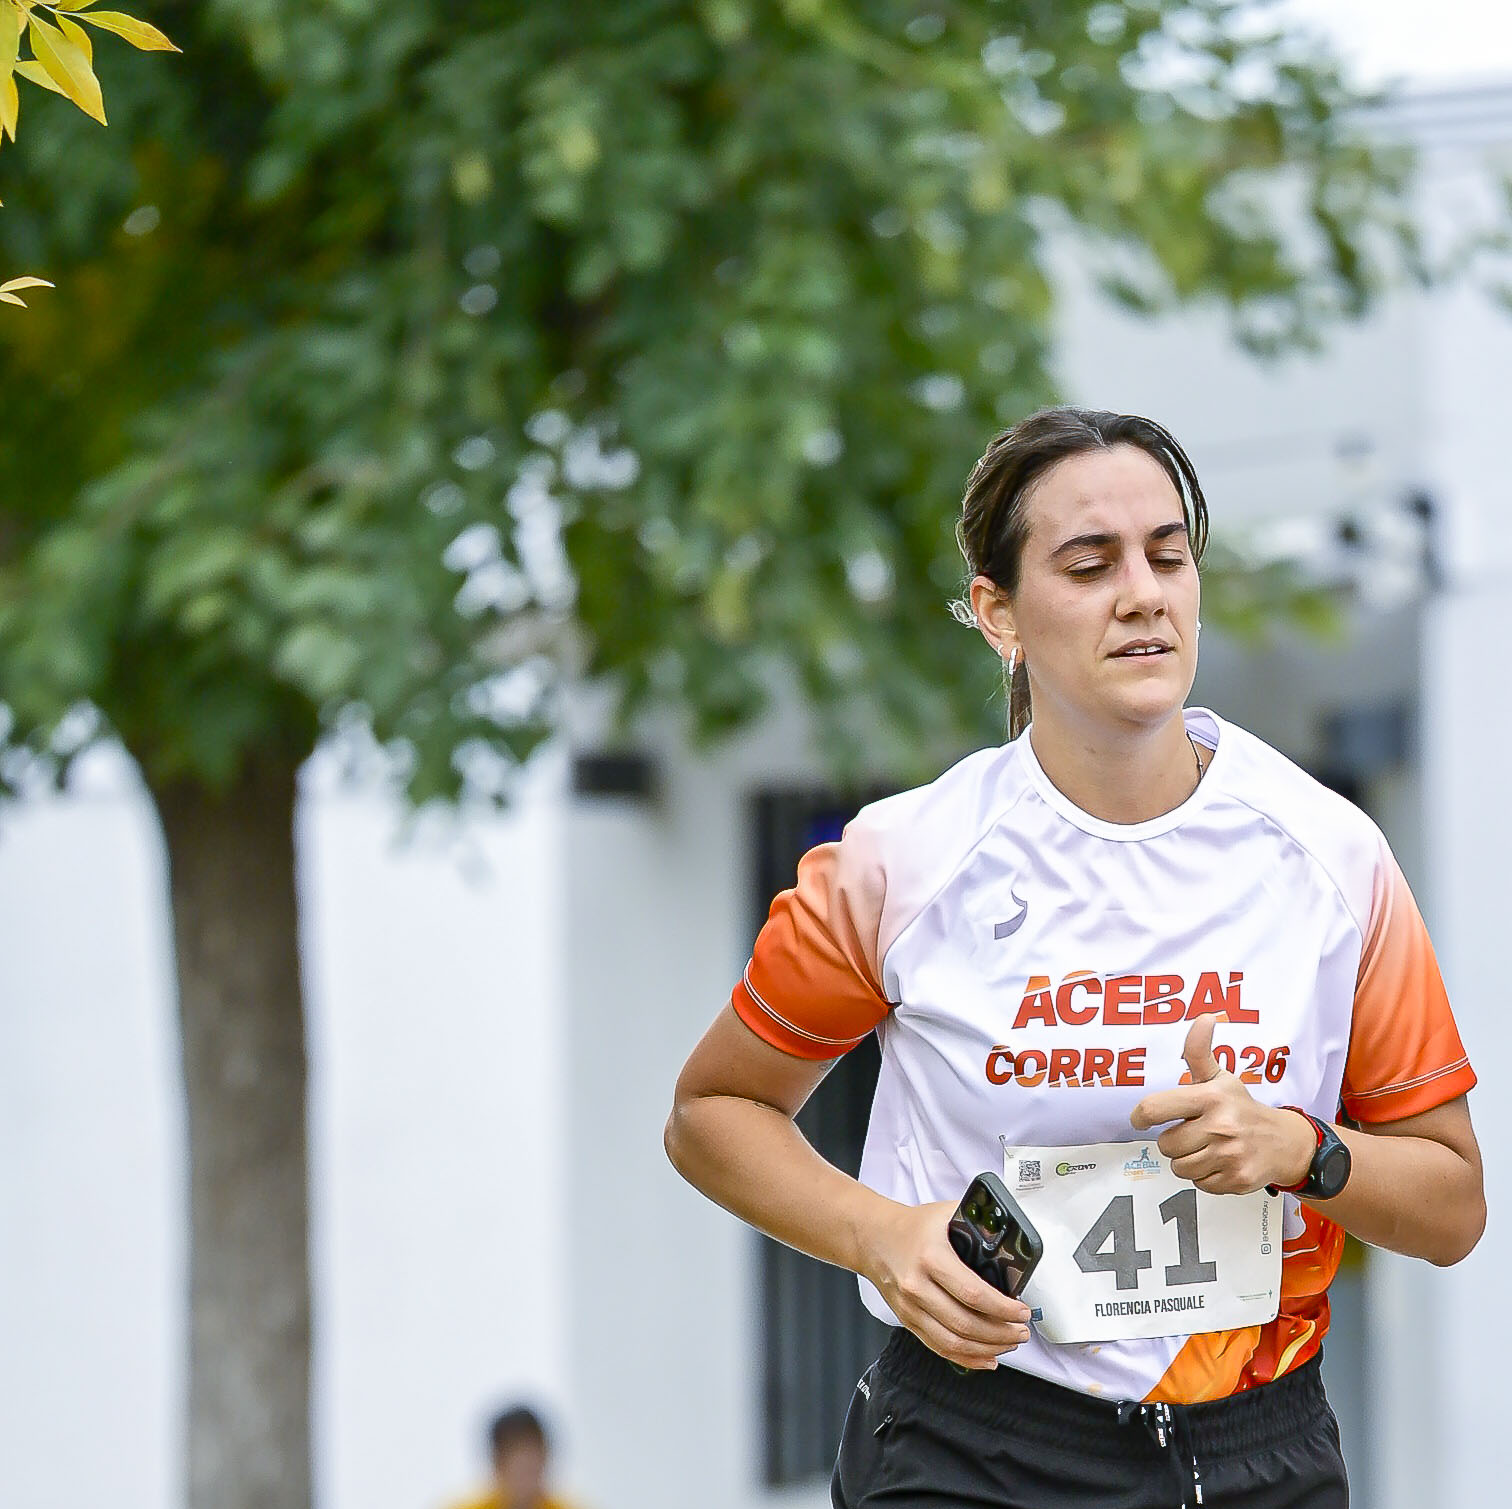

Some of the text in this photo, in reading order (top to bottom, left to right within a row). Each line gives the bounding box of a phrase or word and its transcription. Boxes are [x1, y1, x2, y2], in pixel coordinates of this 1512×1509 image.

[1011, 969, 1260, 1030] ACEBAL
[985, 1044, 1291, 1088] CORRE 026
[1073, 1188, 1217, 1290] 41
[1095, 1295, 1205, 1317] FLORENCIA PASQUALE
